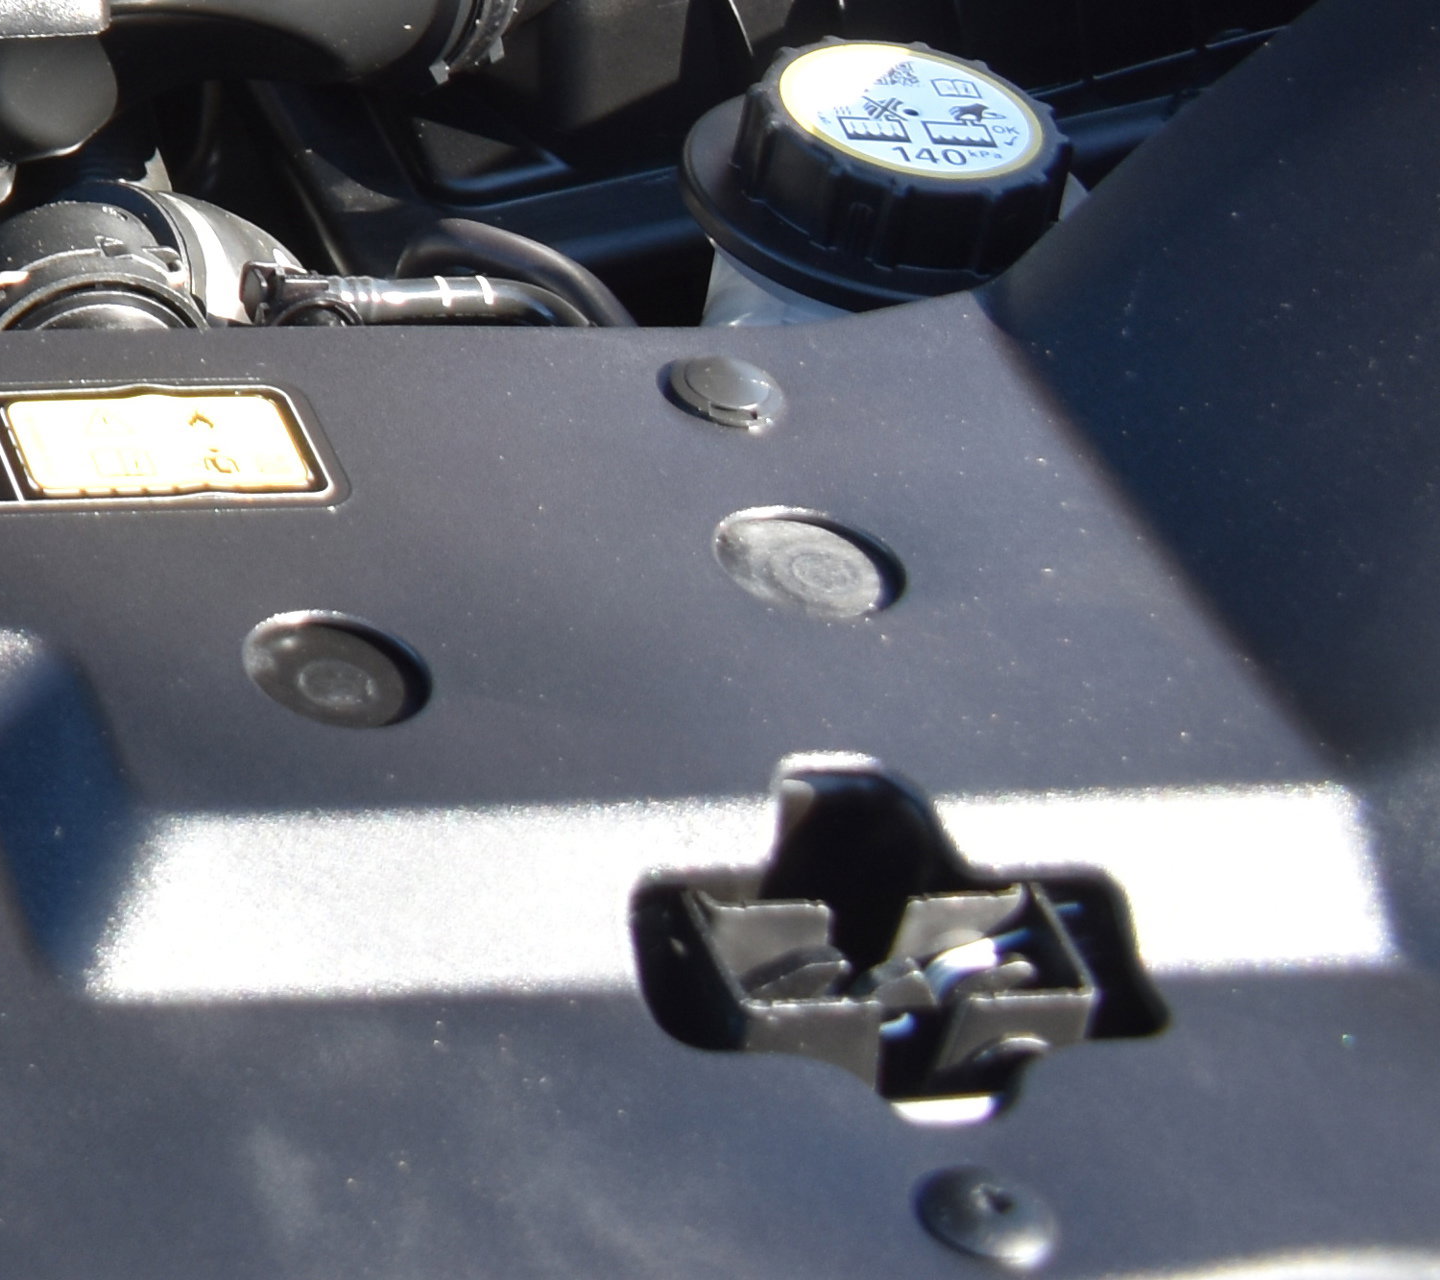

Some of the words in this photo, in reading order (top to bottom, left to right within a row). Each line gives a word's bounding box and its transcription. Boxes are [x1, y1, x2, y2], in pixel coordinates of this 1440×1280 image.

[992, 125, 1020, 135] OK
[892, 146, 967, 166] 140
[968, 149, 1003, 160] kPa
